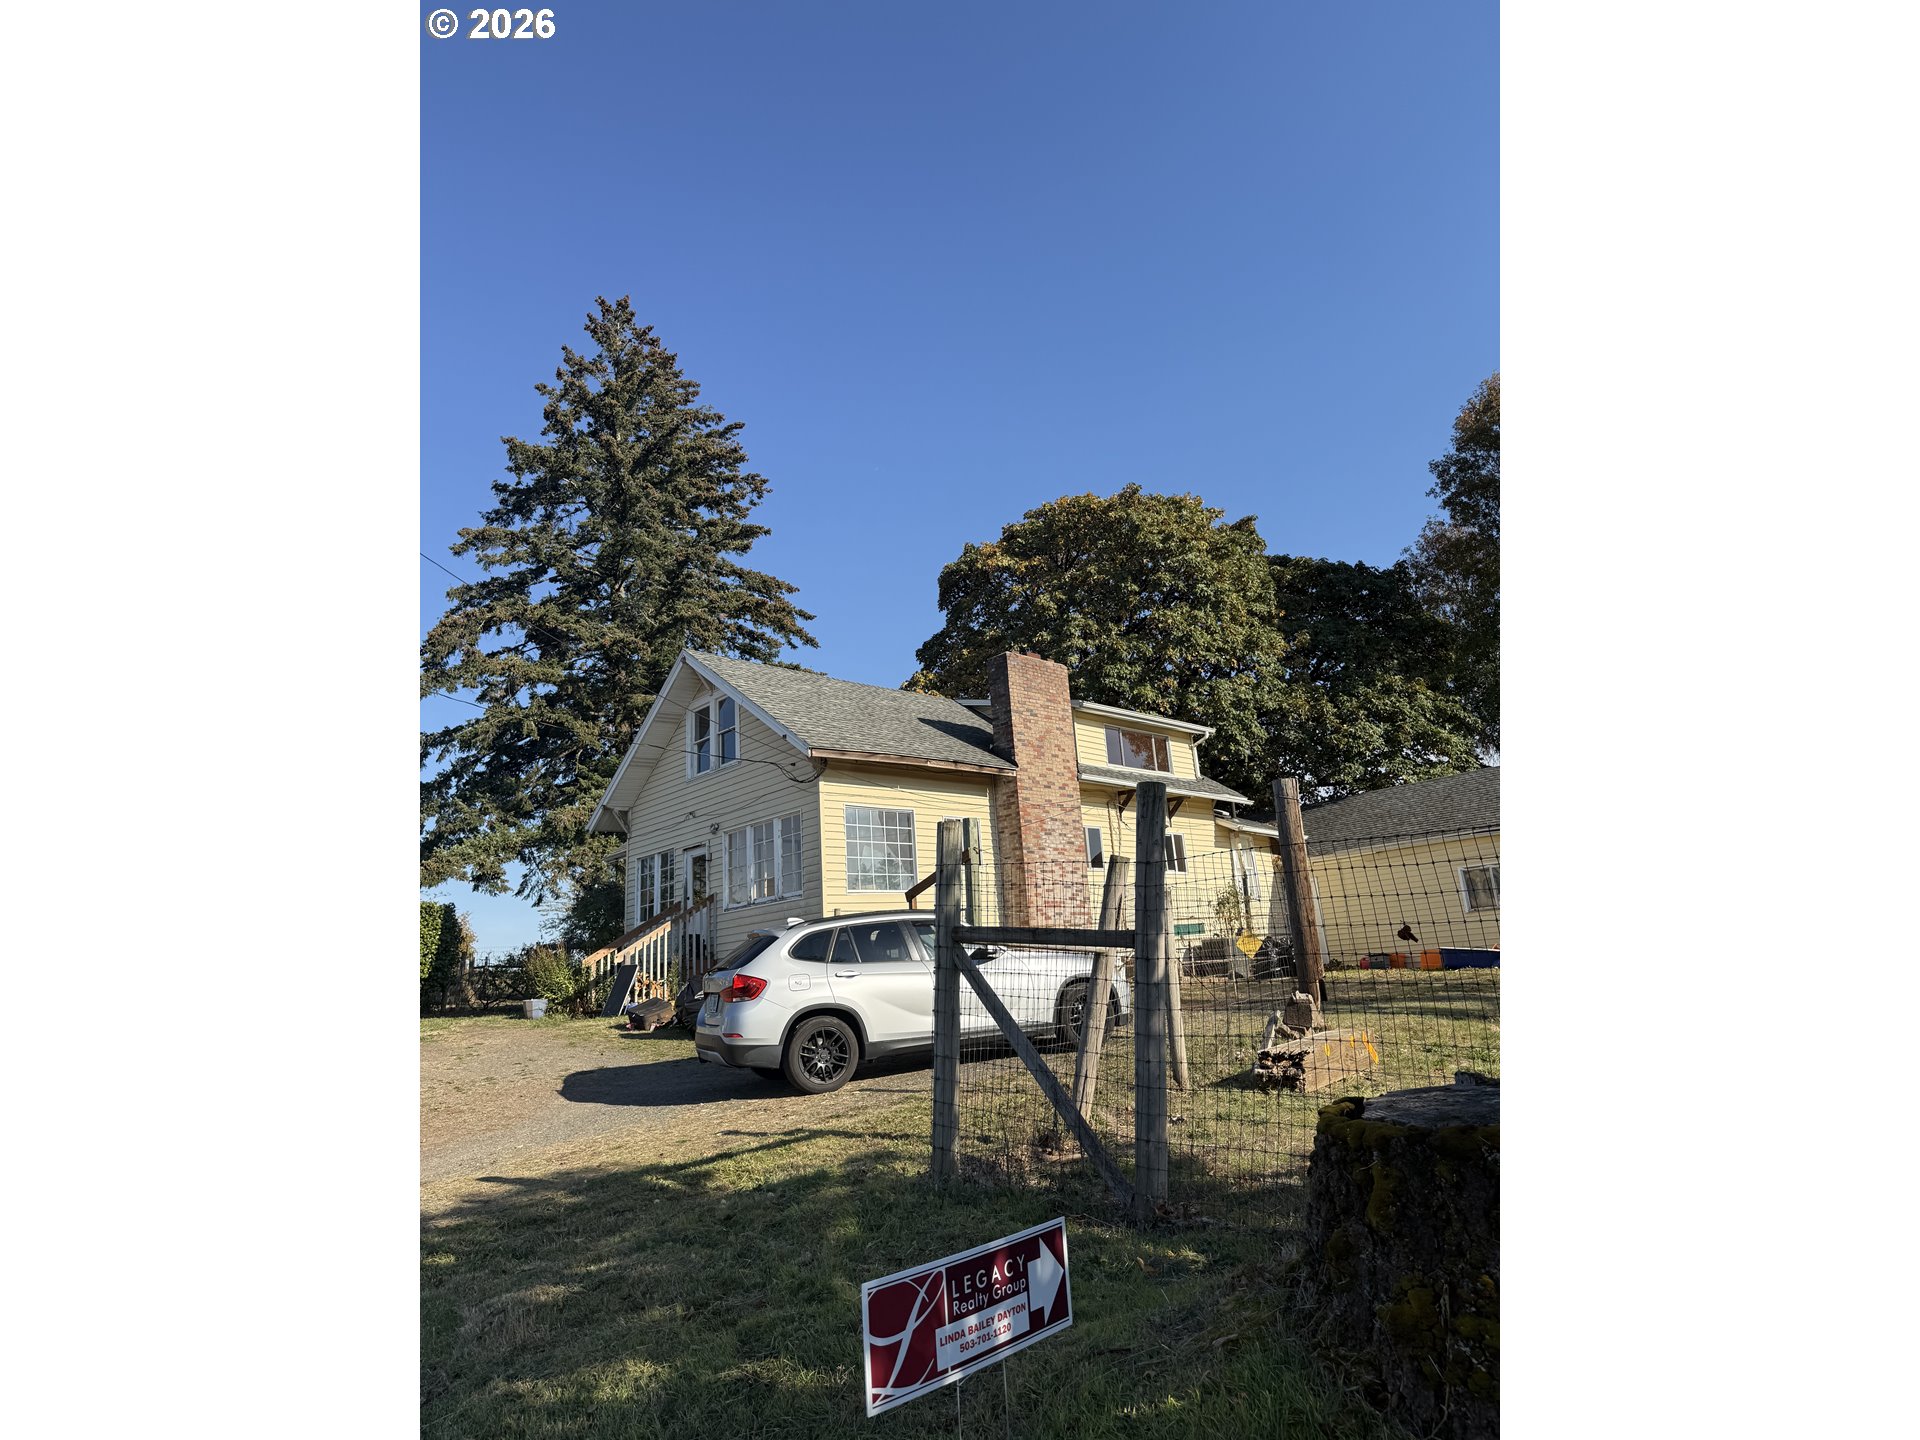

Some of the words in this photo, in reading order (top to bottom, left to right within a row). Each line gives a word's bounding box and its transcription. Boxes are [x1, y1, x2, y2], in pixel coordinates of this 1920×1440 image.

[952, 1254, 1025, 1298] LEGACY
[953, 1292, 989, 1316] Realty
[992, 1278, 1027, 1299] Group
[939, 1329, 966, 1347] LINDA
[967, 1315, 996, 1336] BAILEY
[997, 1302, 1027, 1323] DAYTON
[959, 1322, 1012, 1353] 503-701-1120
